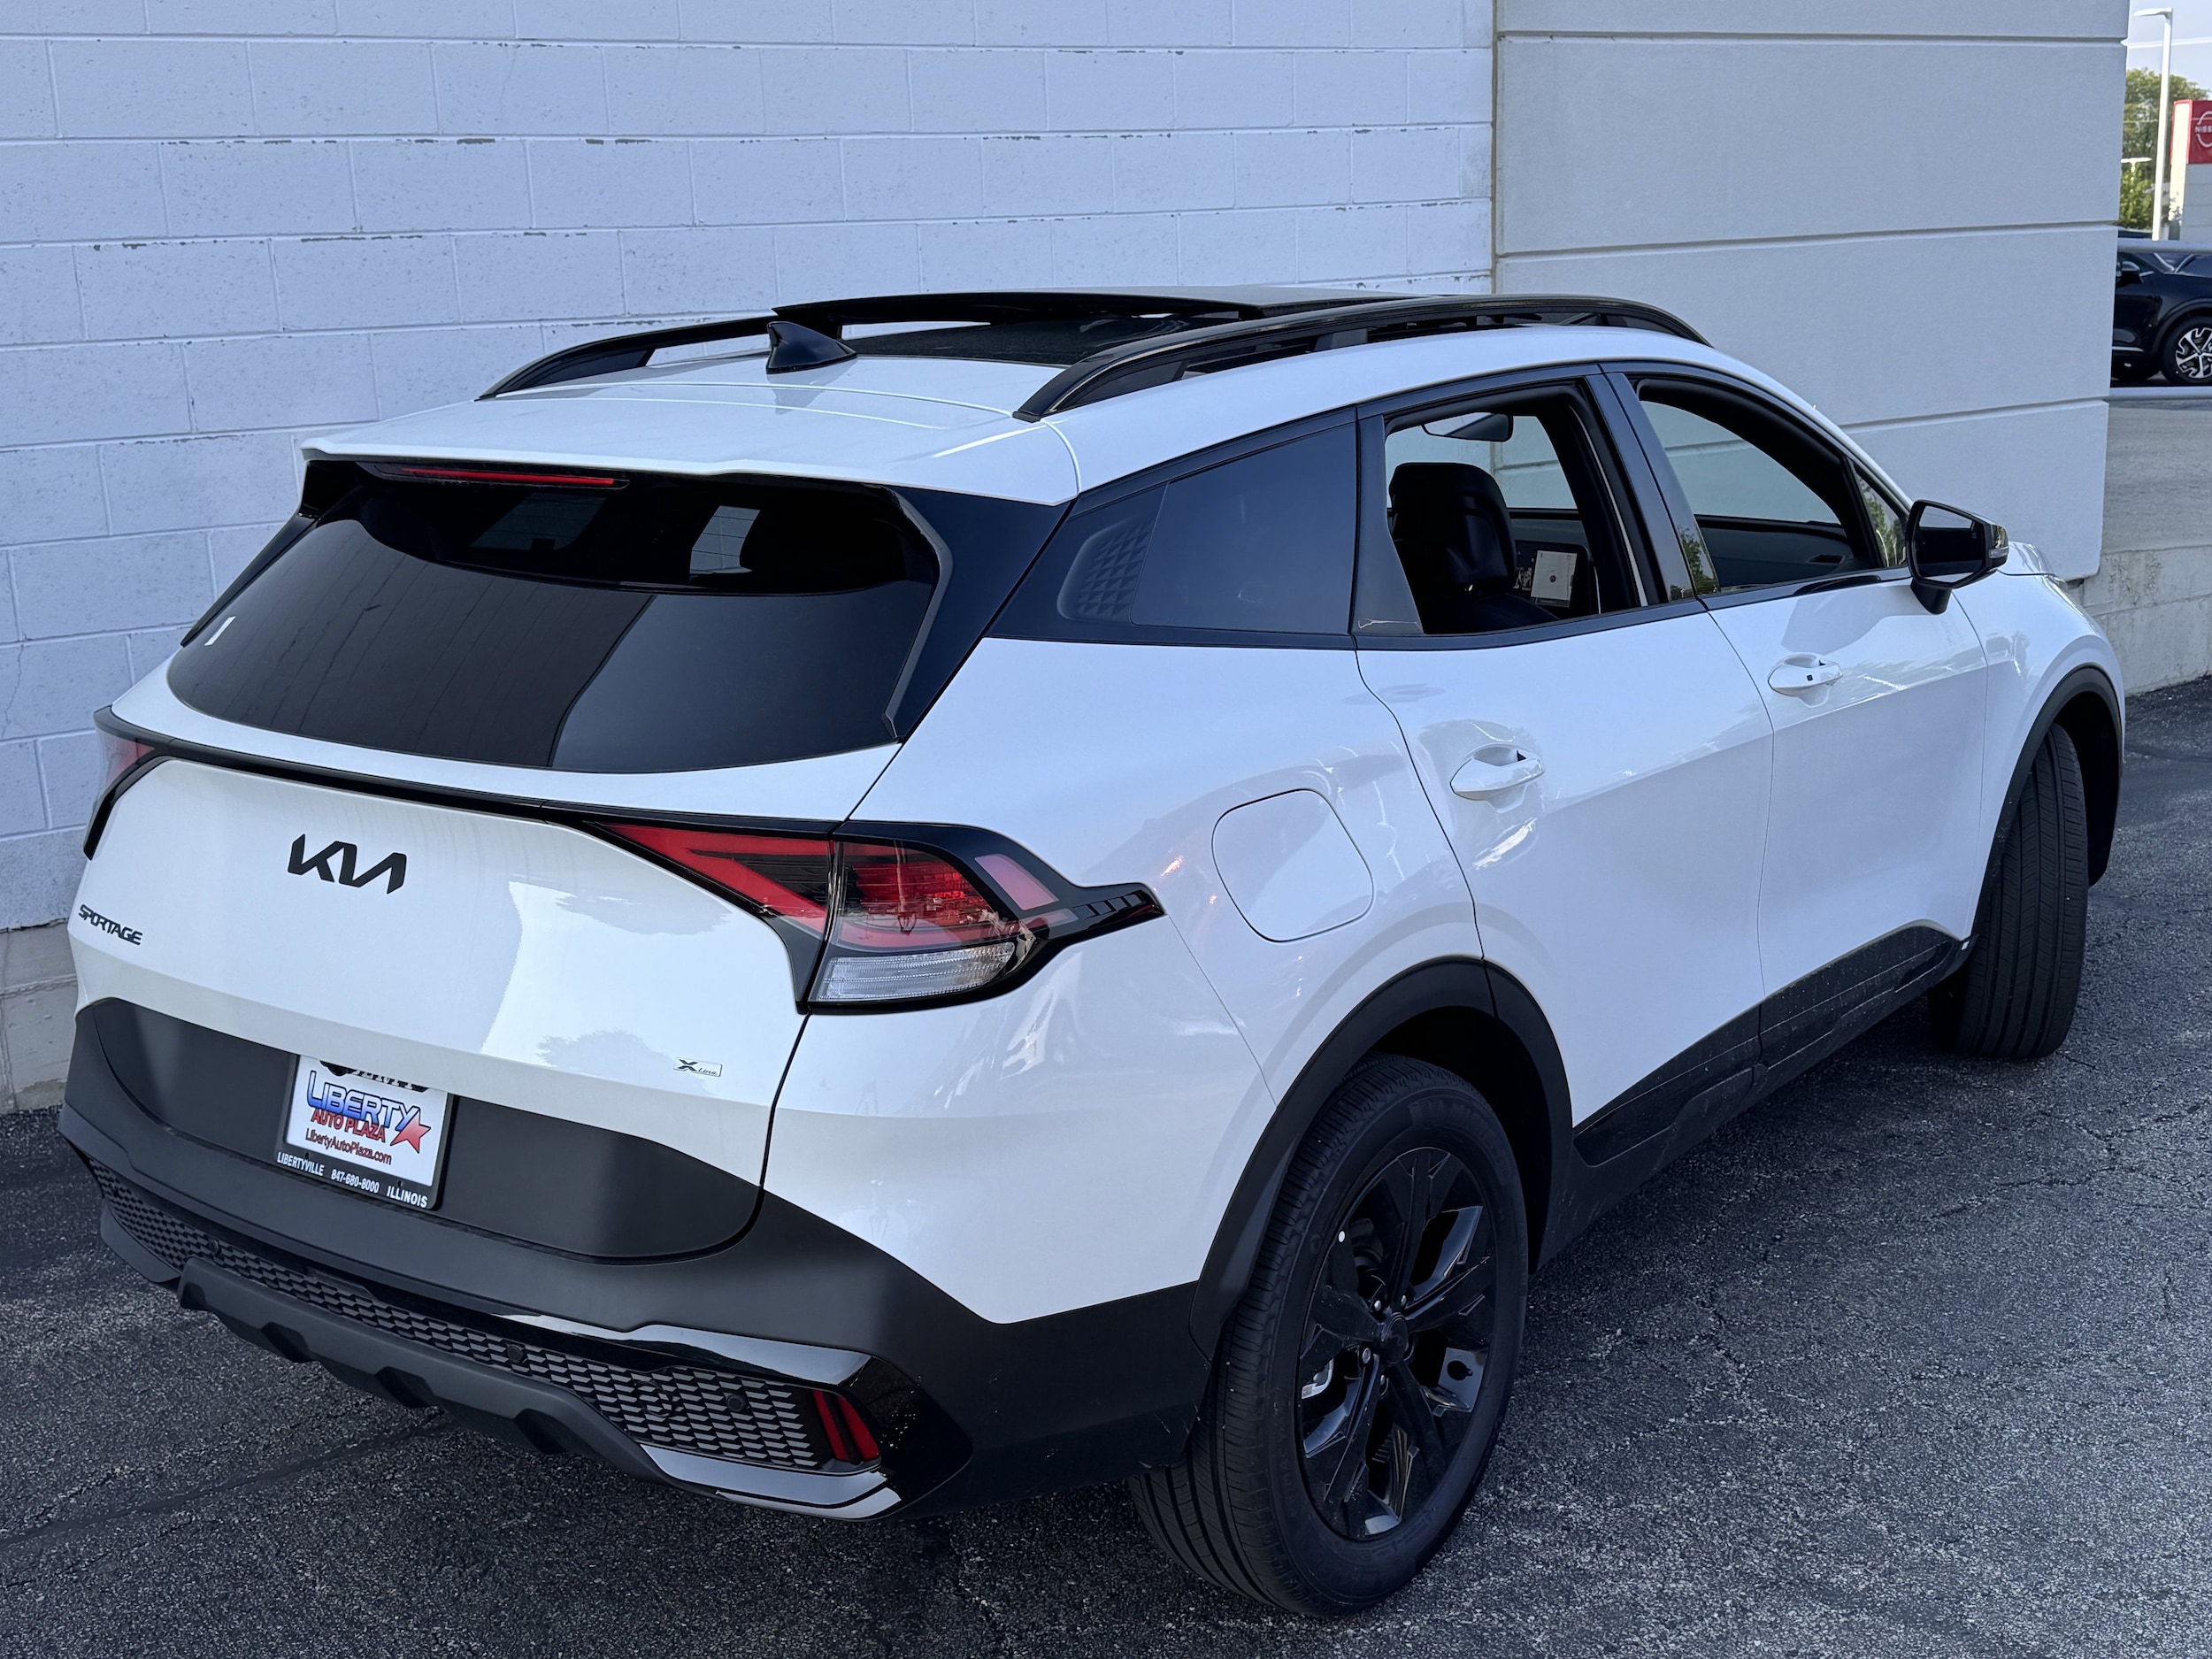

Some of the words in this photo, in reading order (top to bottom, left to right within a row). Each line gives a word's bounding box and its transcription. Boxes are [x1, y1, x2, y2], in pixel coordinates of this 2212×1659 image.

[288, 833, 407, 894] KIA
[78, 903, 143, 945] SPORTAGE
[306, 1070, 421, 1133] LIBERTY
[311, 1109, 343, 1130] AUTO
[344, 1118, 386, 1143] PLAZA
[304, 1127, 392, 1165] LibertyAutoPlaza.com
[276, 1151, 325, 1176] LIBERTYVILLE
[331, 1169, 380, 1194] 847-680-8000
[387, 1185, 428, 1209] ILLINOIS
